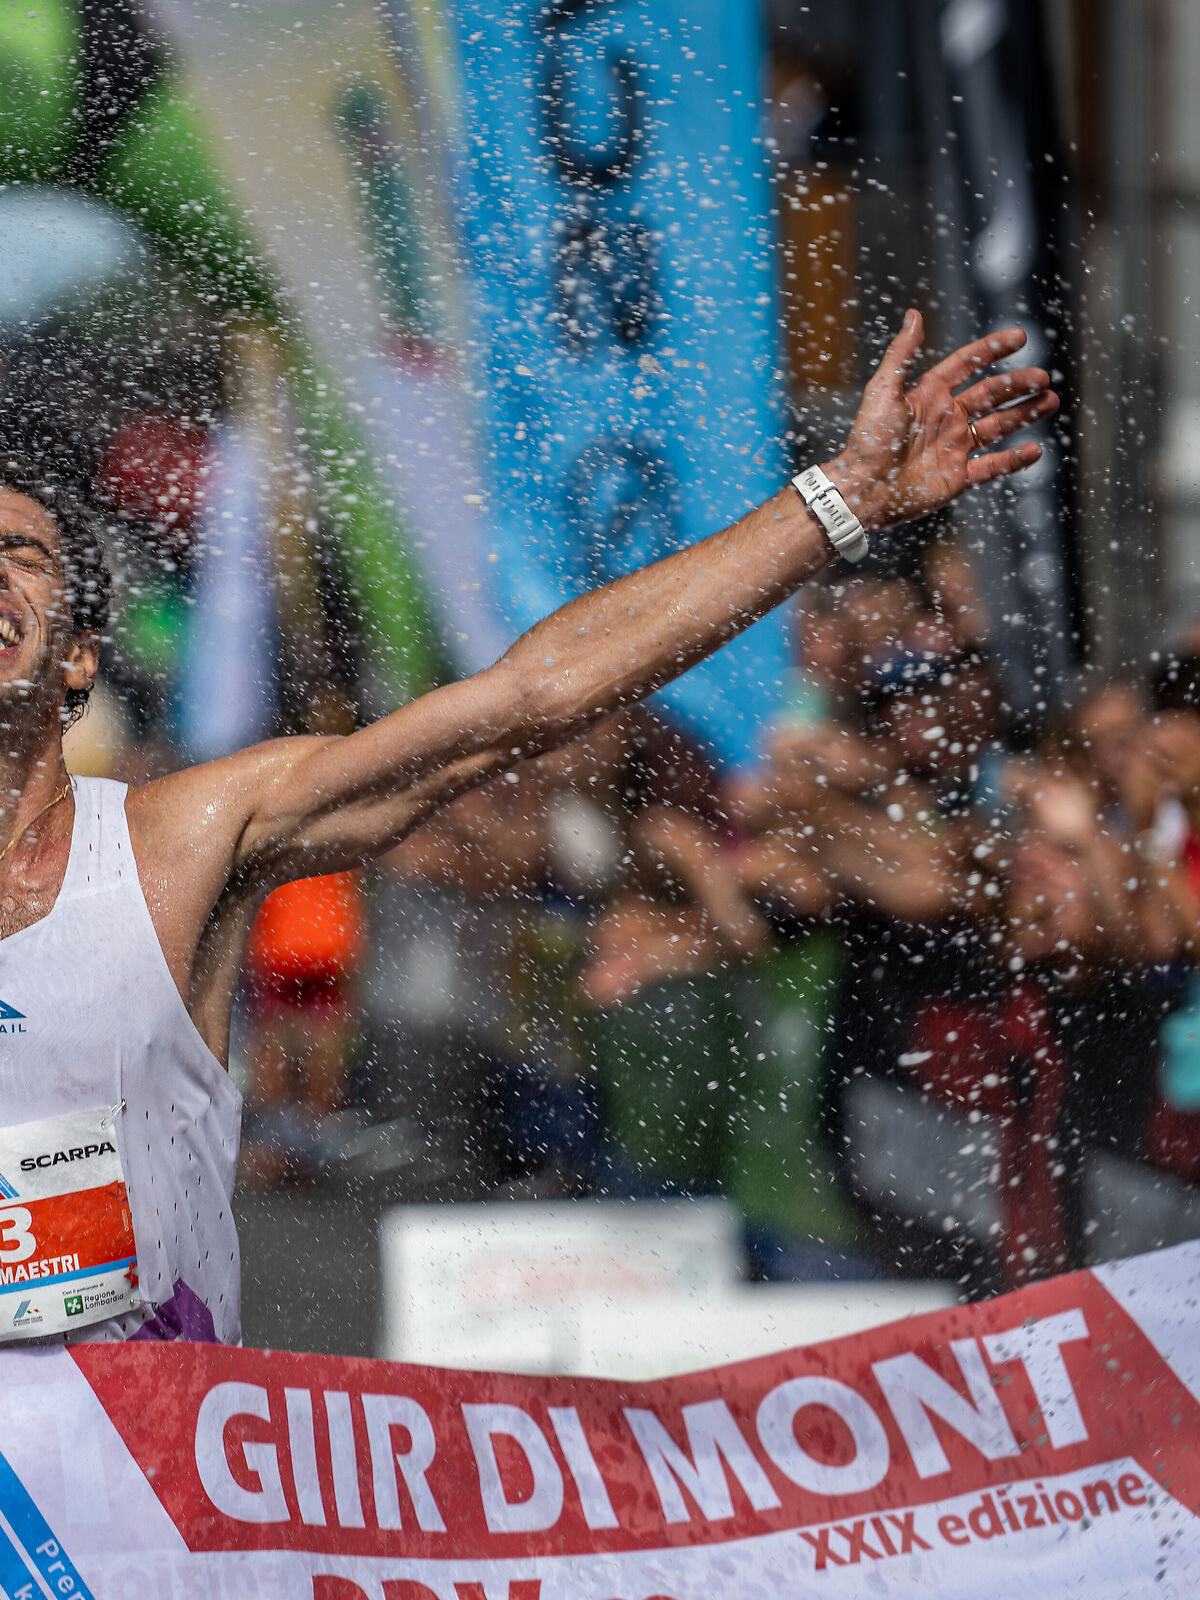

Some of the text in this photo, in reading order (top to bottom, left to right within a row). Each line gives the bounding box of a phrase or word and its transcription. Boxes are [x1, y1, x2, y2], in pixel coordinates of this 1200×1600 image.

[20, 1141, 116, 1171] SCARPA
[84, 1289, 116, 1303] Regione
[85, 1293, 124, 1310] Lombardia
[194, 1307, 1090, 1533] GIIR DI MONT
[797, 1473, 1148, 1571] XXIX edizione
